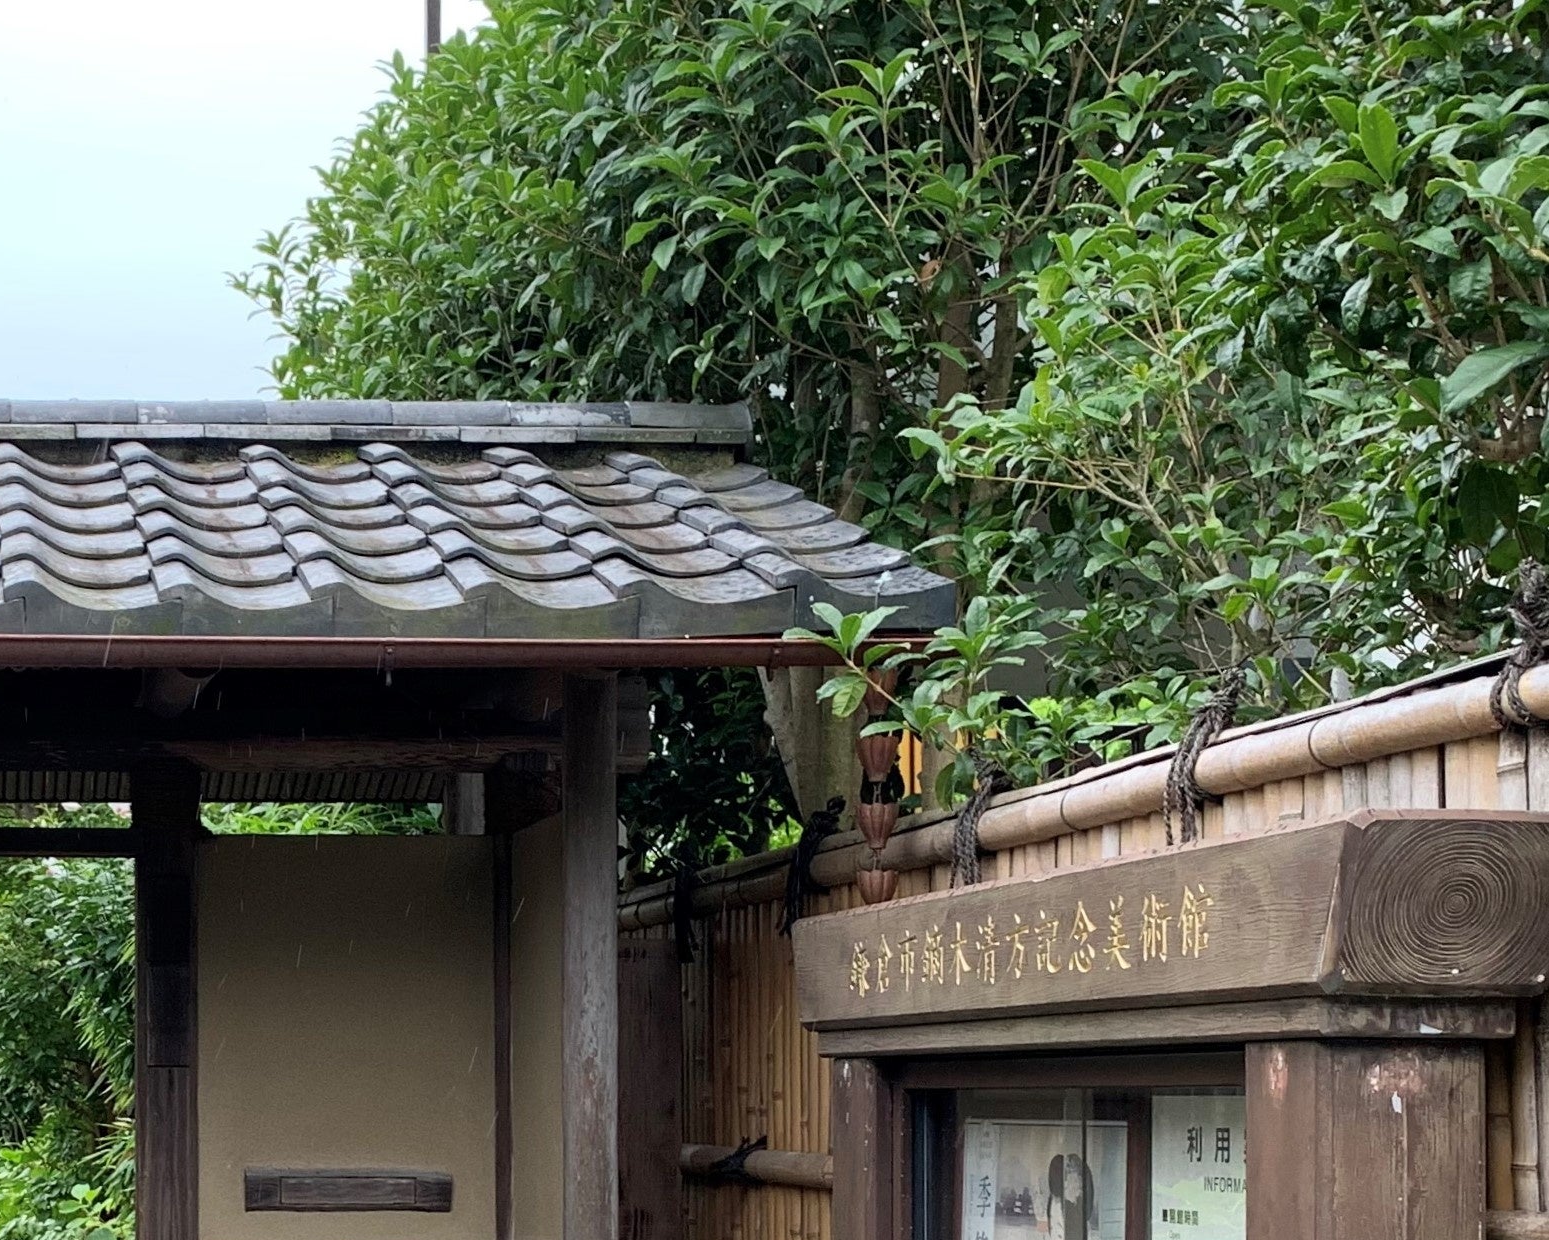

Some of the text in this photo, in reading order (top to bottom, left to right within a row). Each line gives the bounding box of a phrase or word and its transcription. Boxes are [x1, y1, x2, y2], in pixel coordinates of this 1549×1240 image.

[849, 883, 1215, 999] 鎌倉市鏑木清方記念美術館
[1187, 1127, 1246, 1164] 利用
